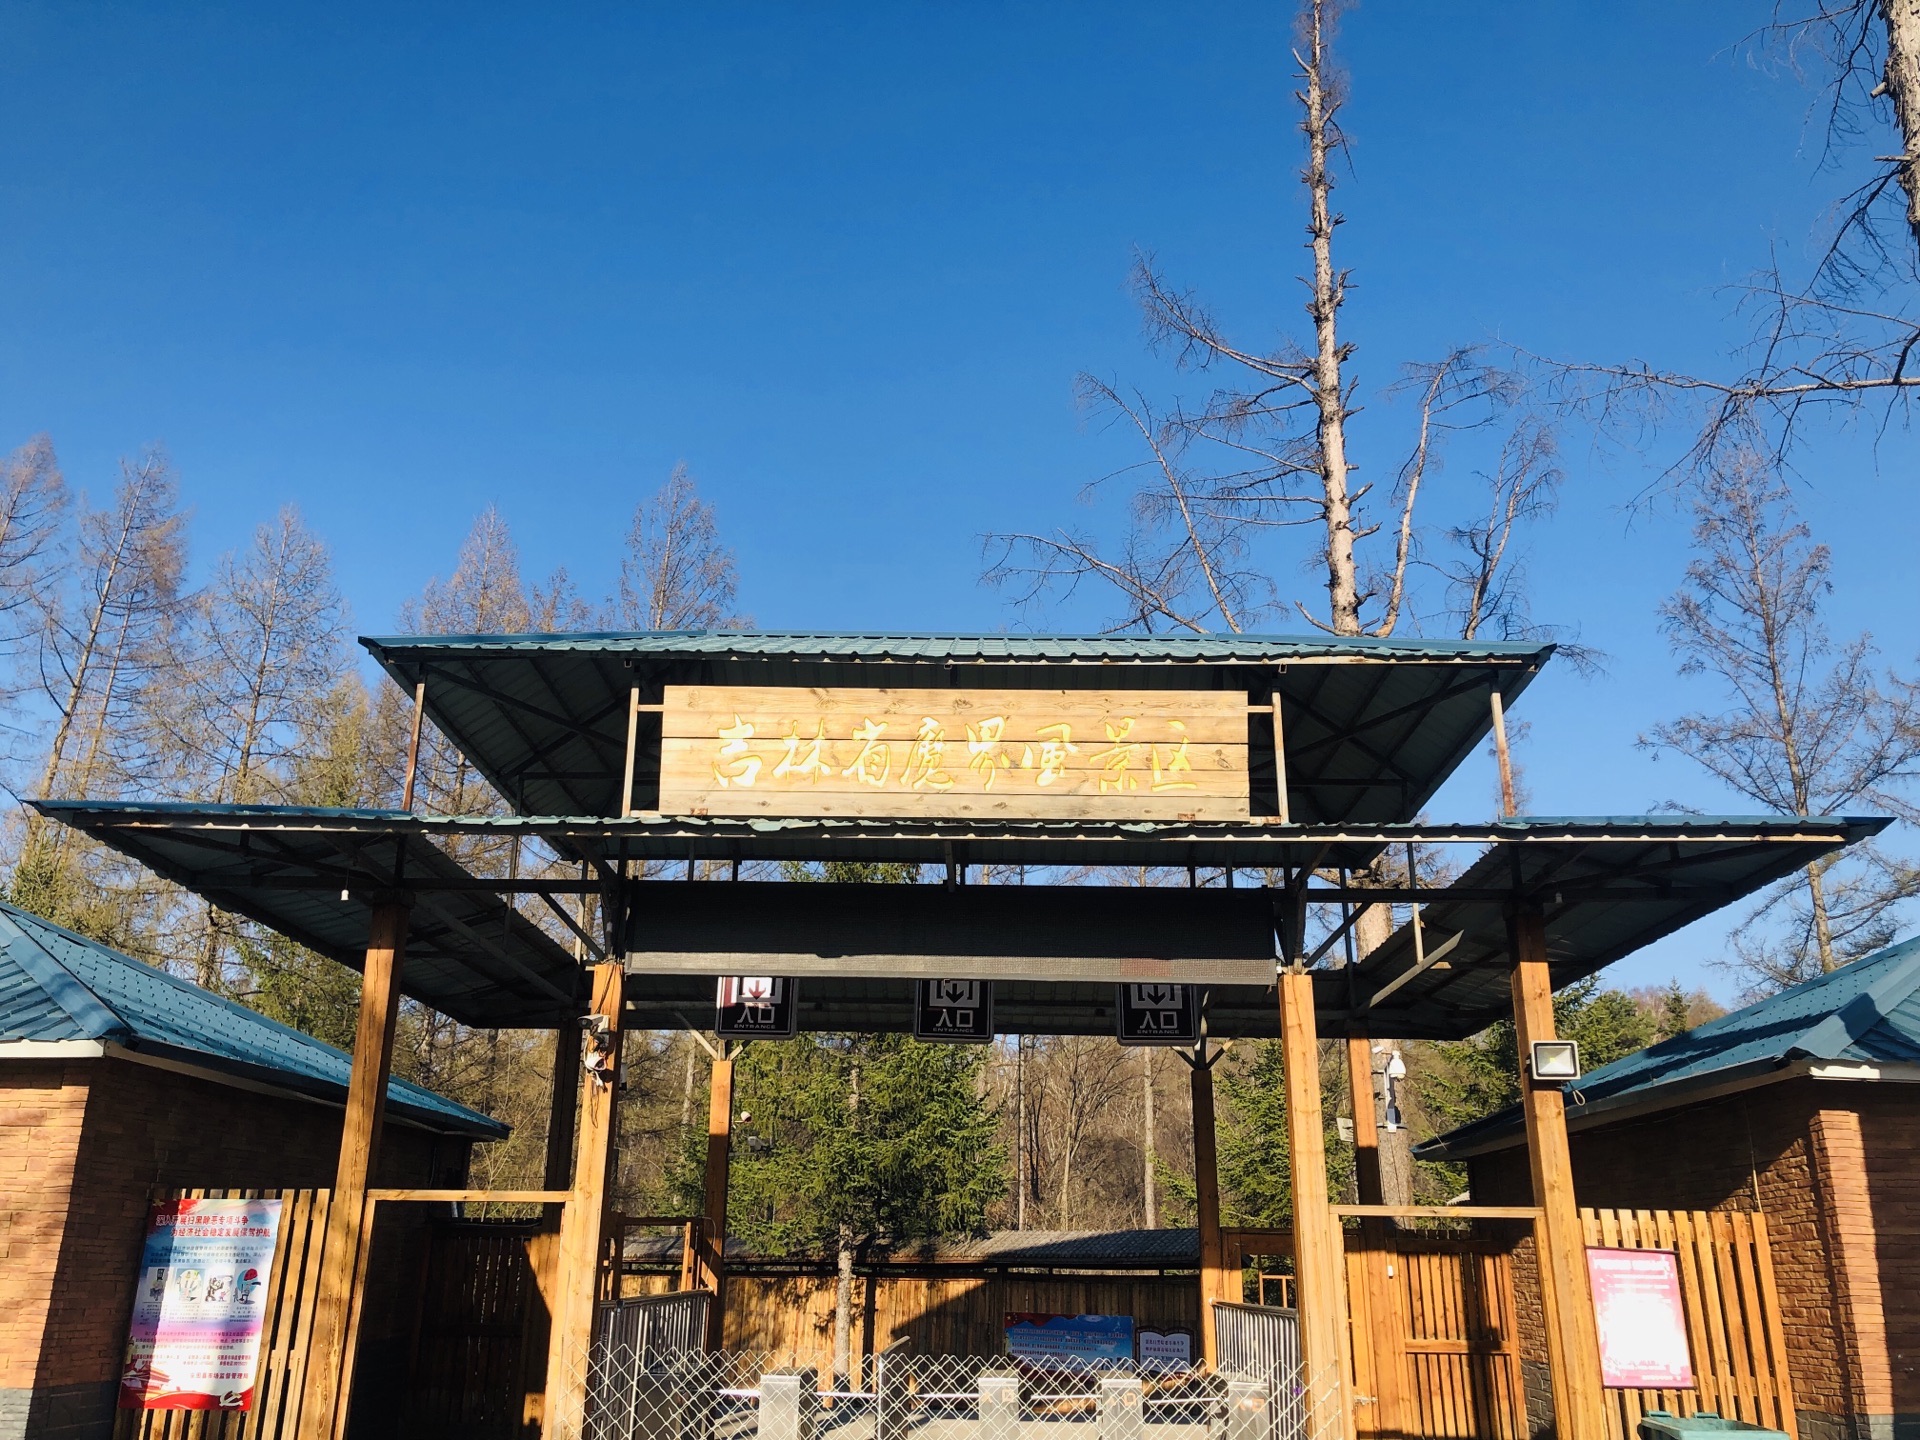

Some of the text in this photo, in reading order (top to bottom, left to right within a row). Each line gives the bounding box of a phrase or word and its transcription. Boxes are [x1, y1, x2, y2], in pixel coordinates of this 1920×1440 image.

[737, 1005, 775, 1024] 入口
[936, 1009, 973, 1027] 入口
[1140, 1011, 1177, 1029] 入口
